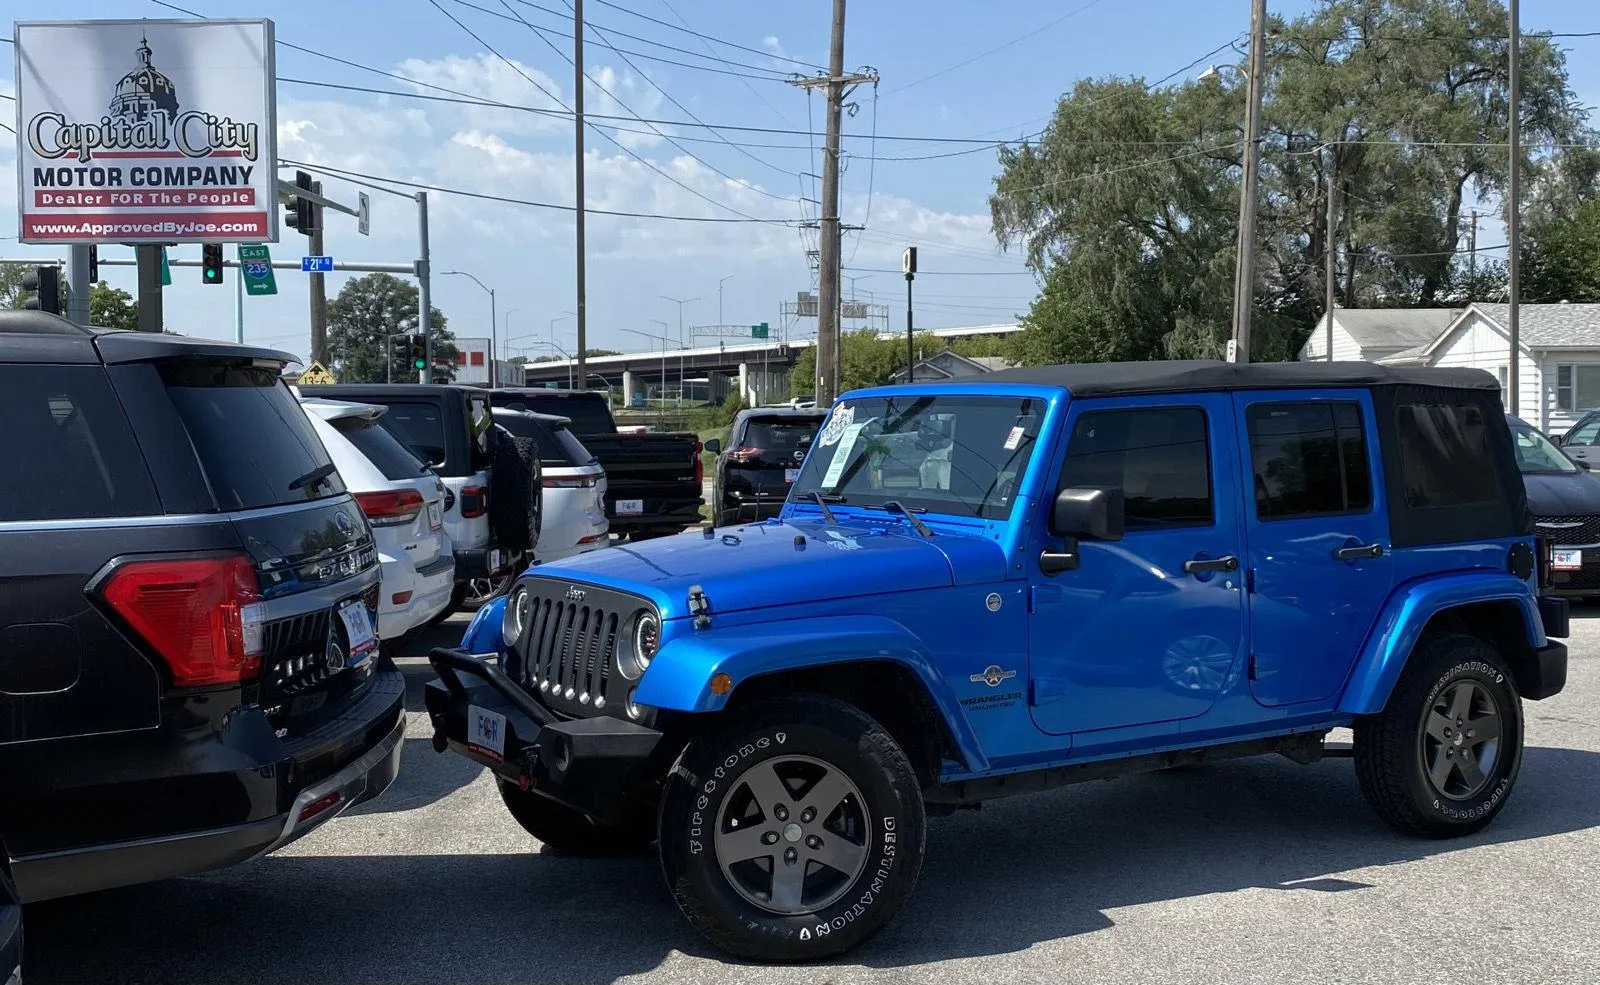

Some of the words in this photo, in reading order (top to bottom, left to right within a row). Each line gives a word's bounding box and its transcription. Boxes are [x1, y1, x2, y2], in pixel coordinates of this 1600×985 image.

[28, 112, 170, 162] Capital
[174, 111, 258, 161] City
[33, 167, 122, 187] MOTOR
[130, 166, 254, 186] COMPANY
[42, 193, 102, 204] Dealer
[110, 193, 143, 204] FOR
[149, 193, 181, 204] The
[187, 191, 249, 205] People
[32, 222, 258, 235] www.ApprovedByJoe.com
[242, 249, 265, 257] EAST
[247, 264, 268, 274] 235
[1428, 661, 1497, 702] DESTINATION
[959, 692, 1024, 705] WRANGLER
[690, 737, 771, 854] Firestone
[816, 816, 896, 937] DESTINATION
